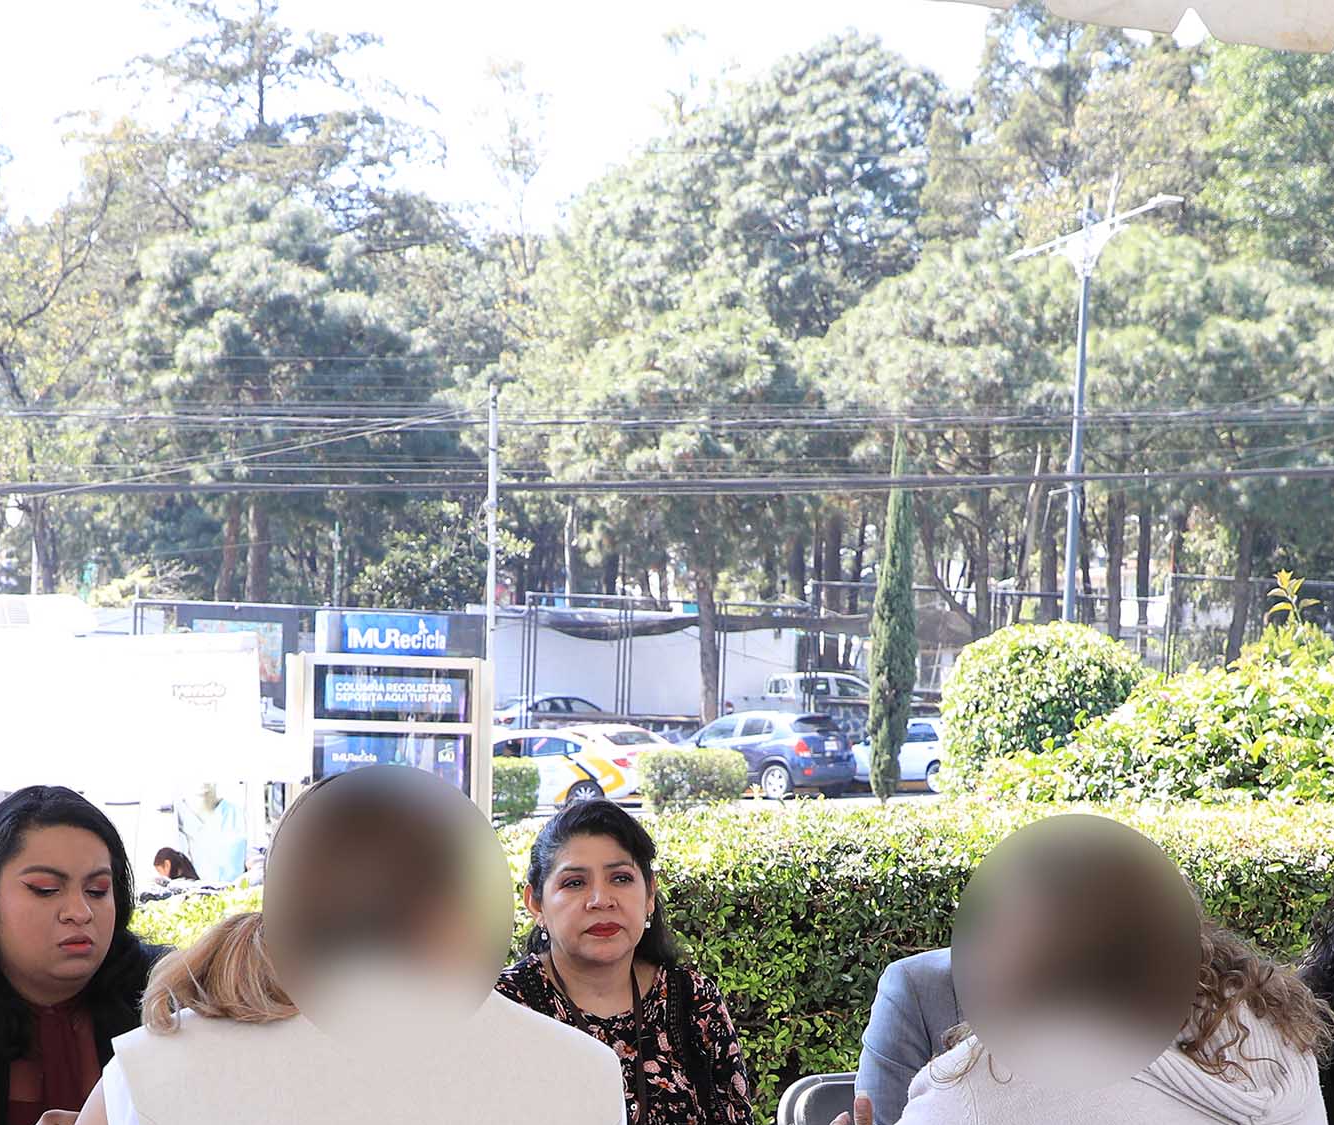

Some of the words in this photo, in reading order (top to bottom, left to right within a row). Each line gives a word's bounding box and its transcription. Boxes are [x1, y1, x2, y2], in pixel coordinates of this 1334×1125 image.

[348, 619, 446, 649] IMURecicla
[335, 682, 385, 692] COLUMNA
[386, 683, 452, 693] RECOLECTORA
[335, 692, 384, 702] DEPOSITA
[408, 693, 427, 702] TUS
